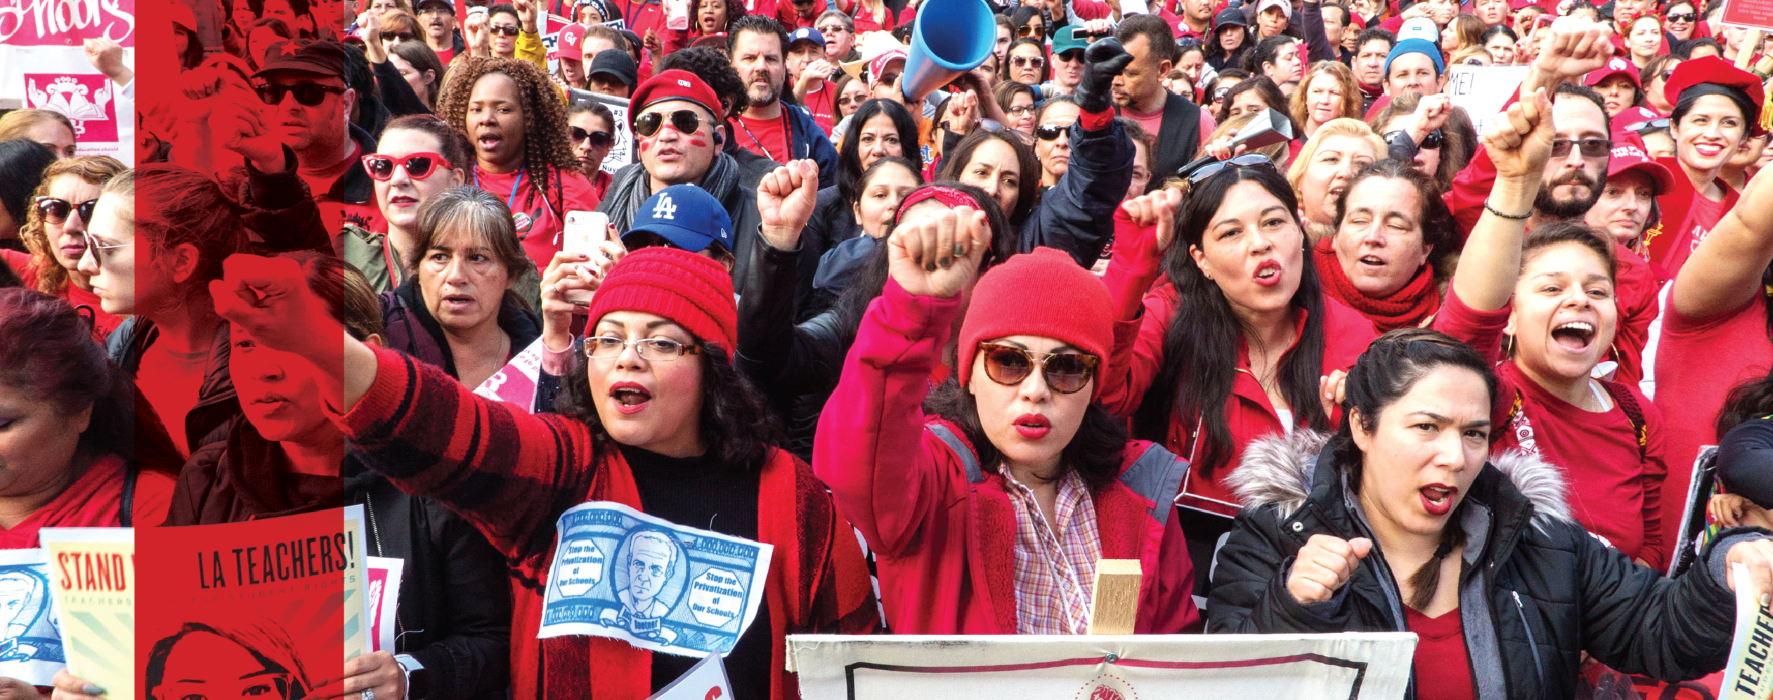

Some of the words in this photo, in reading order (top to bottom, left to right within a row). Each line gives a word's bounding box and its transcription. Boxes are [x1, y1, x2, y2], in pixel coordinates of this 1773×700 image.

[652, 192, 677, 220] LA
[568, 546, 583, 555] Stop
[584, 545, 595, 553] the
[198, 550, 226, 590] LA
[232, 530, 355, 587] TEACHERS!
[561, 556, 603, 567] Privatization
[57, 551, 126, 592] STAND
[573, 567, 580, 575] of
[568, 577, 596, 586] Schools
[705, 572, 724, 583] Stop
[724, 577, 737, 586] the
[228, 585, 296, 602] STUDENT
[304, 575, 356, 591] RIGHTS
[693, 581, 743, 599] Privatization
[712, 597, 720, 605] of
[692, 603, 706, 612] Our
[706, 606, 735, 619] Schools
